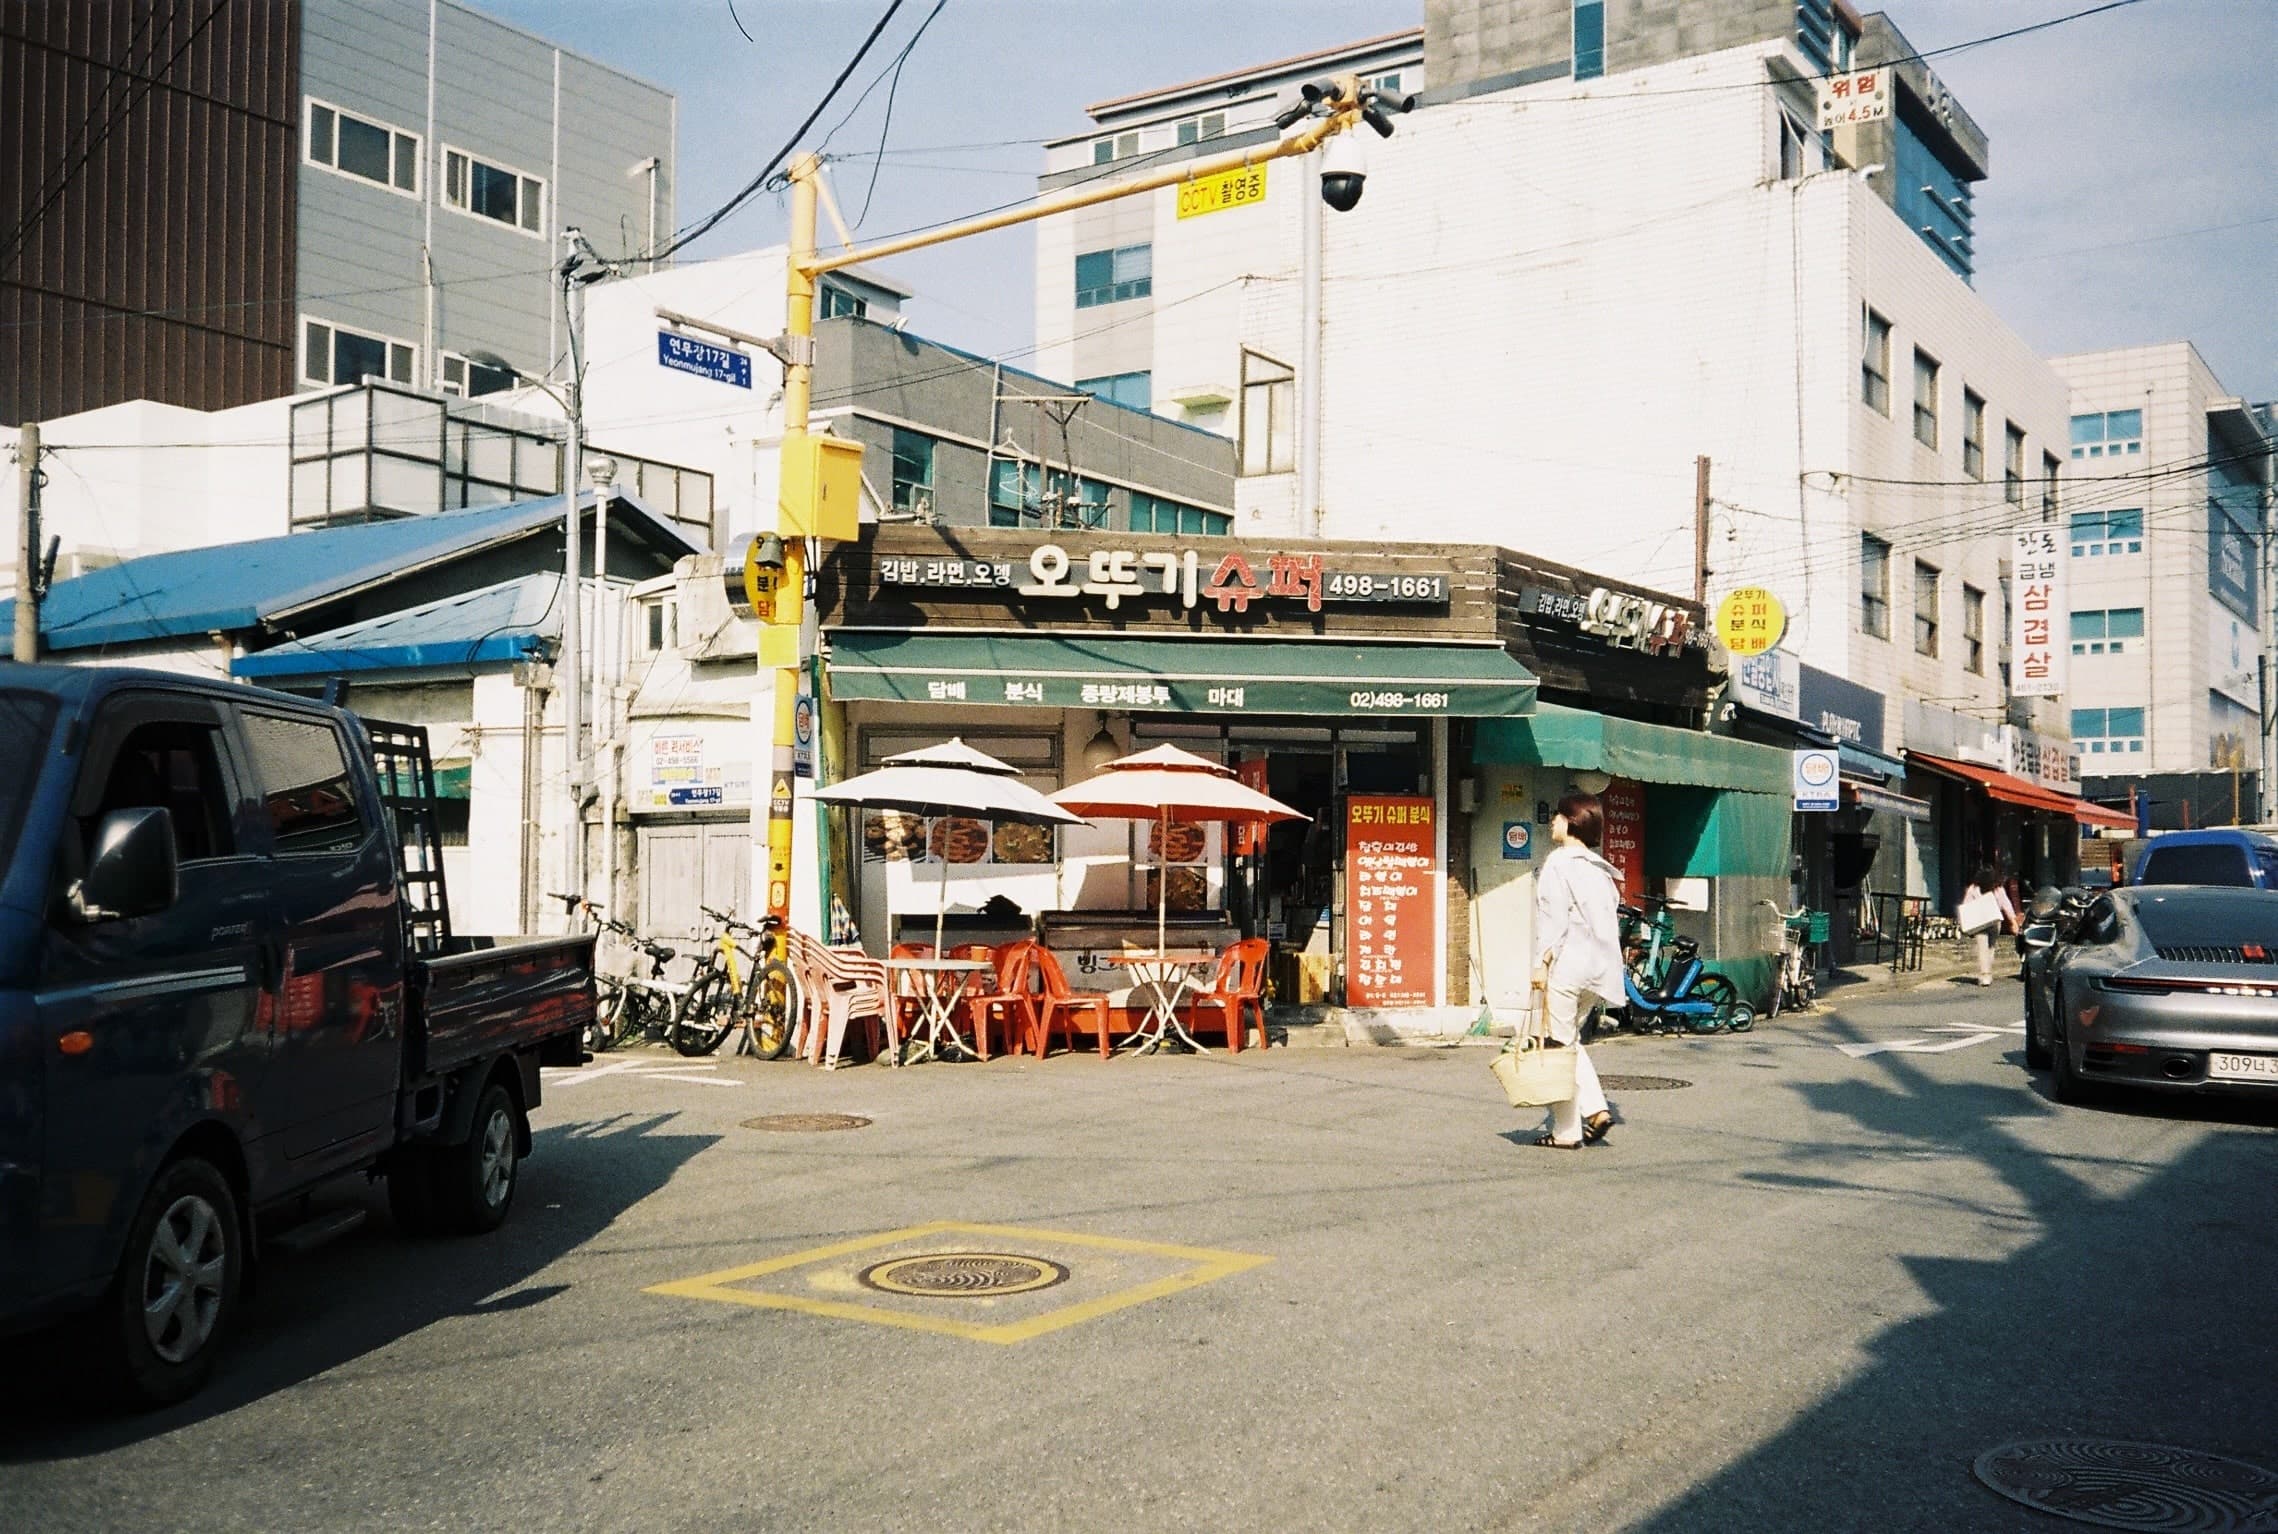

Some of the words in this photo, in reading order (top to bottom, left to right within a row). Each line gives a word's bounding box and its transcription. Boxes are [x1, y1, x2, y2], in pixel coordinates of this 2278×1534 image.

[1832, 74, 1876, 99] 위험
[669, 338, 730, 369] 연무장17길
[663, 353, 713, 378] Yeonmujang
[714, 368, 736, 384] 17-gil
[1018, 544, 1199, 610] 오뚜기
[1202, 551, 1324, 613] 슈퍼
[1329, 574, 1441, 599] 498-1661
[2019, 562, 2055, 580] 급냉
[1731, 603, 1767, 616] 슈퍼
[1731, 619, 1766, 631] 분식
[2023, 583, 2052, 679] 삼겹살
[1730, 637, 1767, 650] 담배
[927, 681, 967, 700] 담배
[1004, 682, 1044, 702] 분식
[1080, 684, 1171, 705] 종량제봉투
[1208, 687, 1244, 708] 마대
[1350, 691, 1449, 709] 02)498-1661
[1351, 805, 1384, 824] 오뚜기
[1409, 805, 1430, 825] 분식
[2219, 1056, 2266, 1072] 309너
